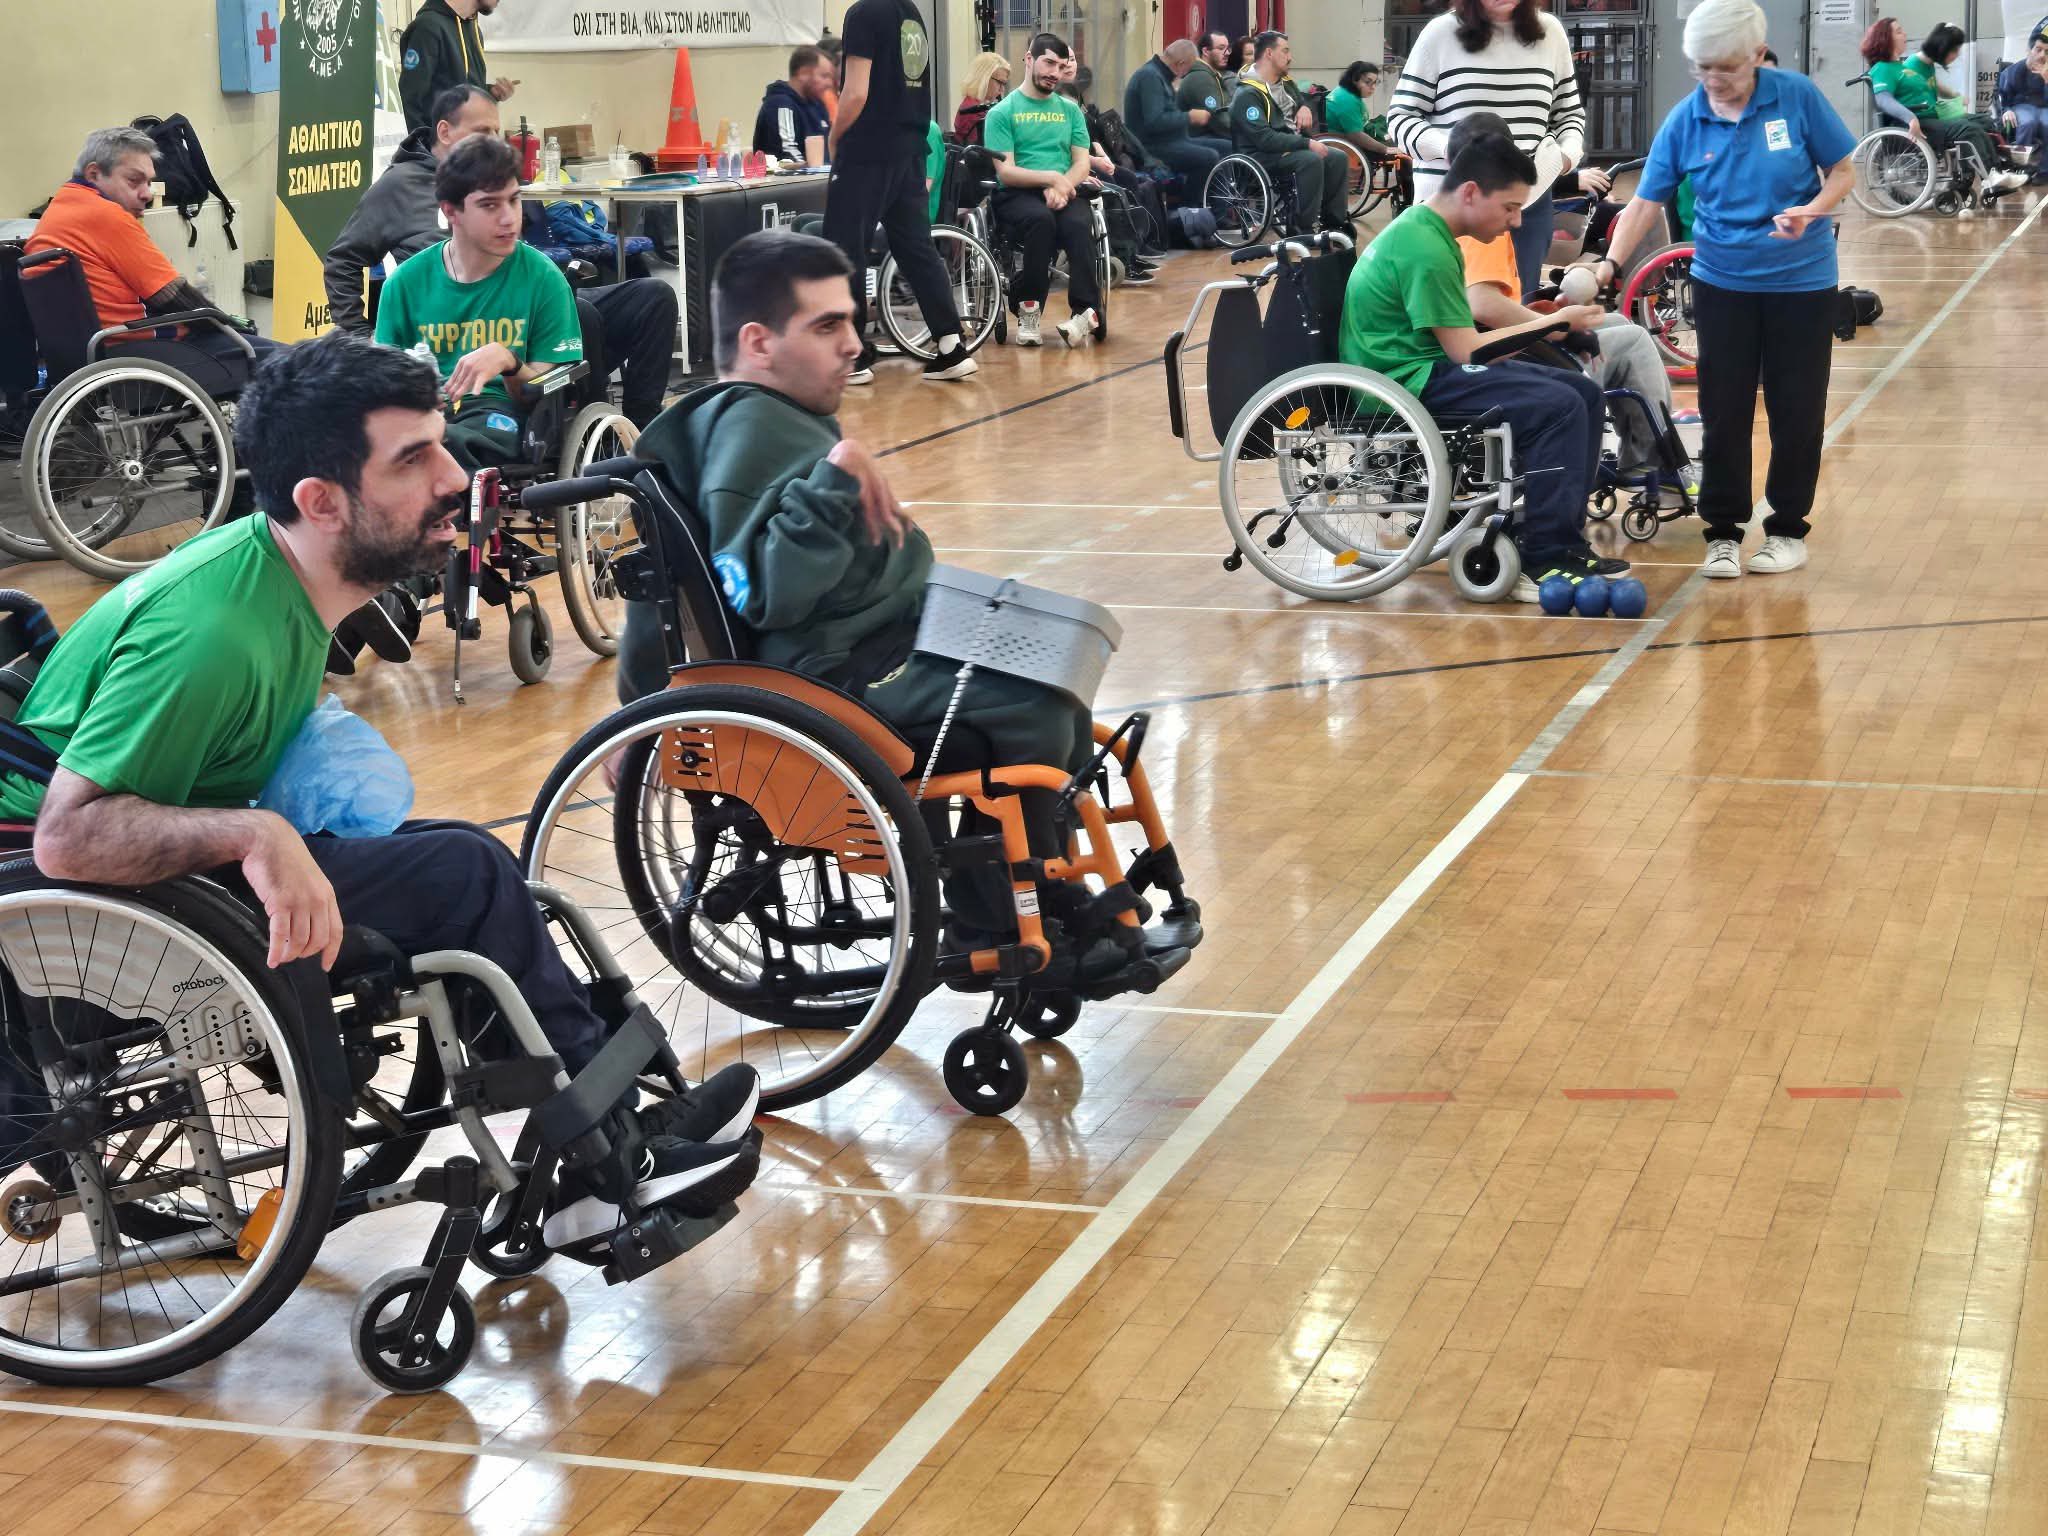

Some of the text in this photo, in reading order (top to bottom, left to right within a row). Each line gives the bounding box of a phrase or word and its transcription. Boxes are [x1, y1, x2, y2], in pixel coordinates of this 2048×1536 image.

[573, 11, 751, 37] ΟΧΙ ΣΤΗ ΒΙΑ, ΝΑΙ ΣΤΟΝ ΑΘΛΗΤΙΣΜΟ
[316, 33, 337, 53] 2005
[907, 32, 922, 57] 20
[288, 119, 362, 154] ΑΘΛΗΤΙΚΟ
[288, 159, 361, 196] ΣΩΜΑΤΕΙΟ
[304, 302, 333, 336] Αμε
[418, 317, 527, 354] ΤΥΡΤΑΙΟΣ
